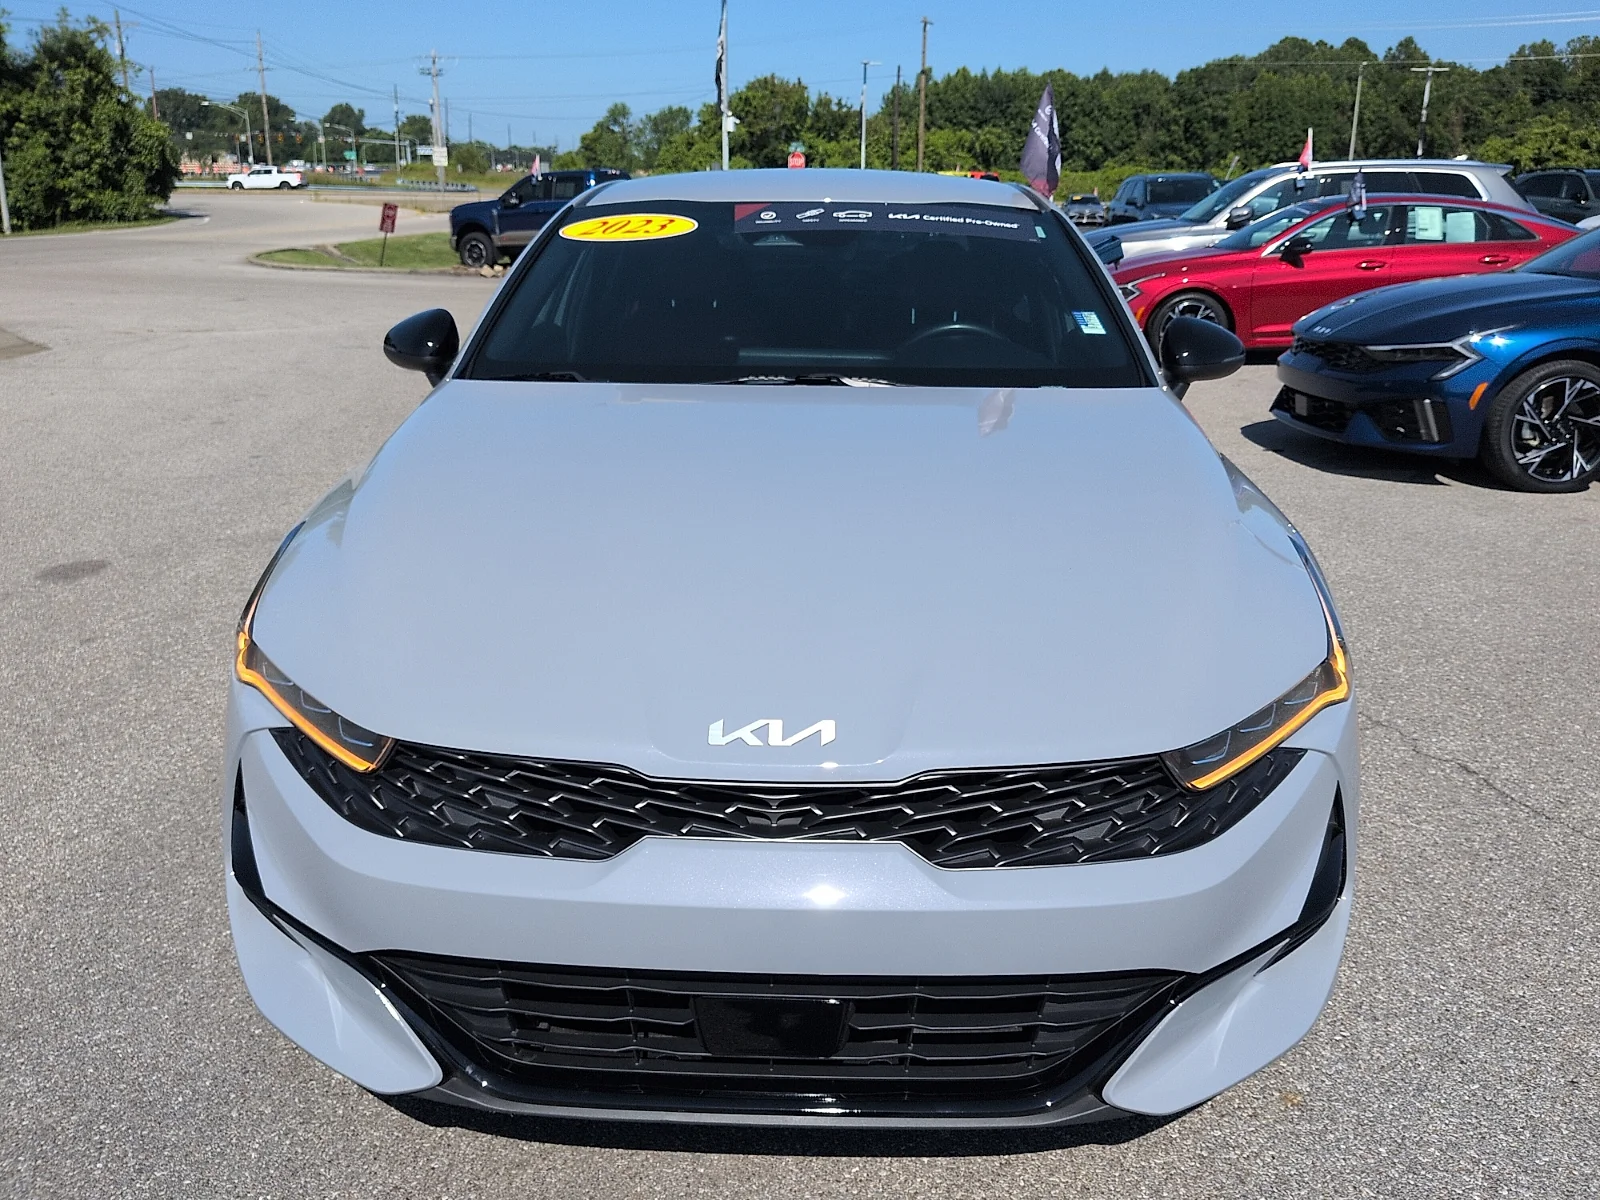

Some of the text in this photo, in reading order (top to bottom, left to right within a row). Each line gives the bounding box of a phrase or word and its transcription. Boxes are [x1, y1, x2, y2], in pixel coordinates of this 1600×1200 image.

[788, 157, 805, 166] STOP
[576, 219, 676, 237] 2023
[922, 214, 964, 224] Certified
[965, 217, 1019, 229] Pre-Owned
[707, 718, 837, 747] KIA
